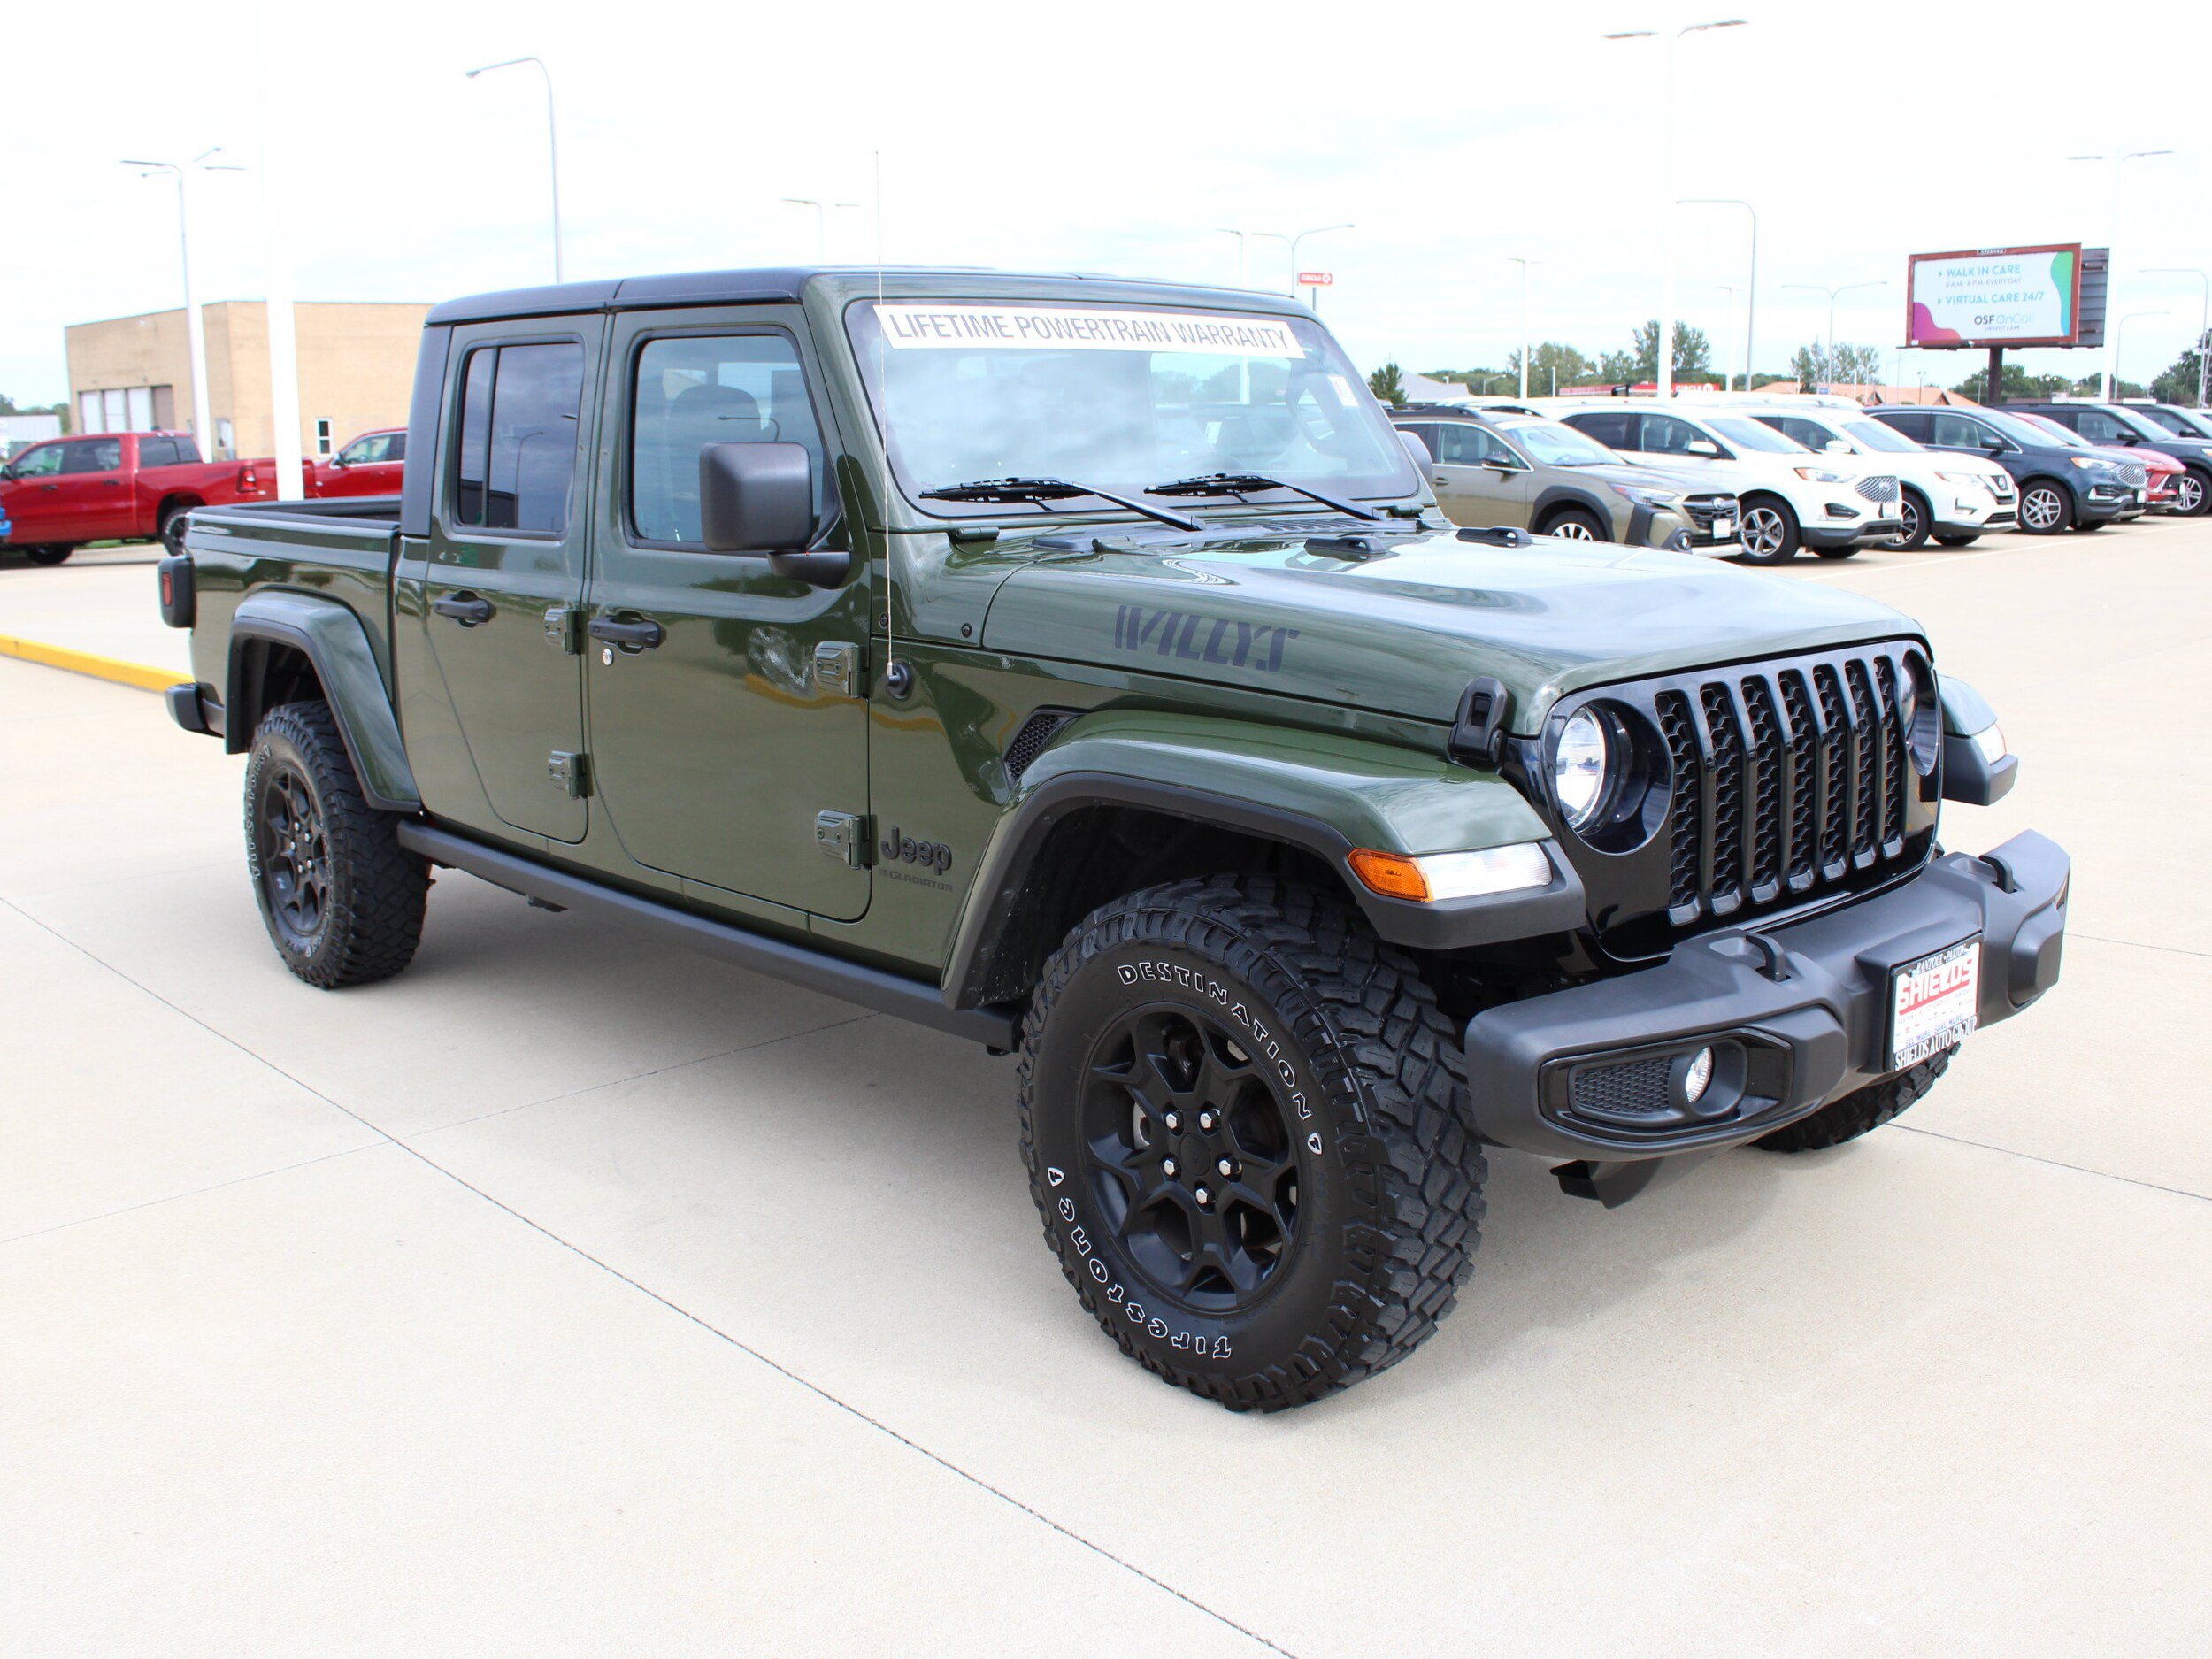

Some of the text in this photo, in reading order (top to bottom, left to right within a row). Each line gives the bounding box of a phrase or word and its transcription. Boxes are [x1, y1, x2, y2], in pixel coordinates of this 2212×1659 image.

[1947, 265, 2021, 277] WALK IN CARE
[1946, 291, 2045, 305] VIRTUAL CARE 24/7
[1974, 314, 1995, 326] OSF
[889, 314, 1291, 350] LIFETIME POWERTRAIN WARRANTY
[1115, 605, 1301, 672] WILLYS
[880, 826, 952, 876] Jeep
[1898, 958, 1972, 1010] SHIELDS
[1117, 962, 1313, 1121] DESTINATION
[1895, 1042, 1930, 1071] SHIELDS
[1930, 1031, 1952, 1056] AUTO
[1058, 1196, 1233, 1359] Firestone
